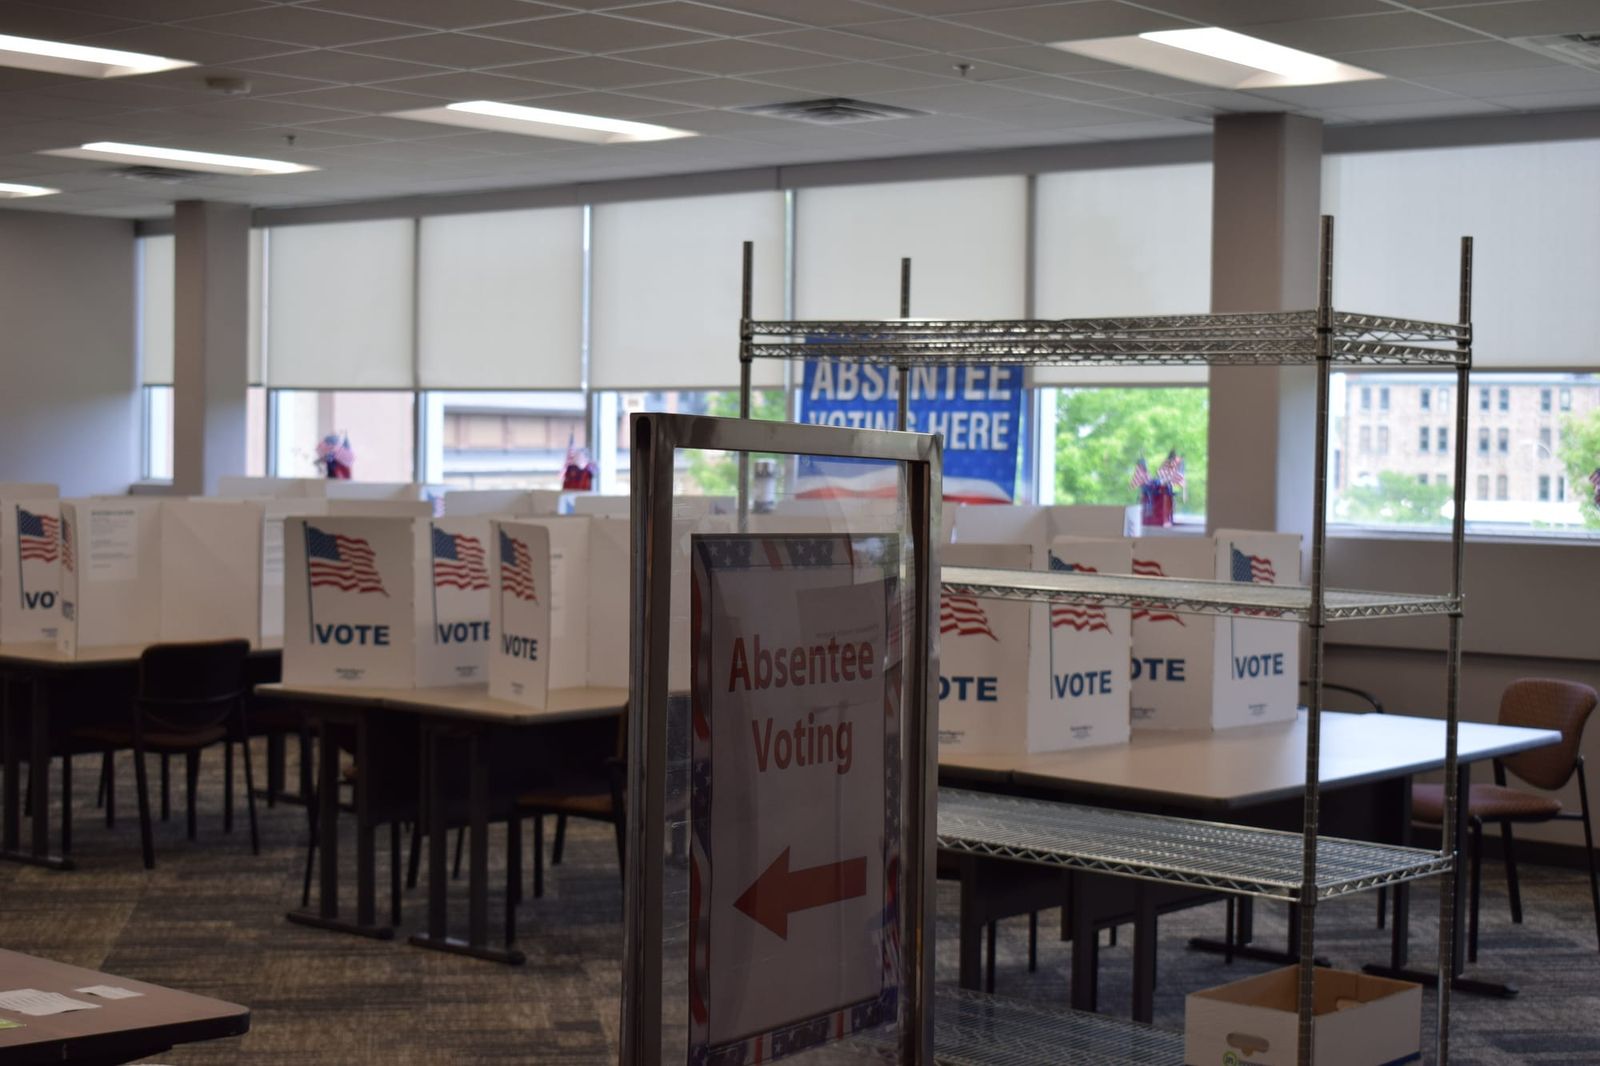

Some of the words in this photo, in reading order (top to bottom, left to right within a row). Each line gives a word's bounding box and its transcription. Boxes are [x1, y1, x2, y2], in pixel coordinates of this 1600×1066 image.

[928, 411, 1011, 450] HERE
[25, 590, 59, 609] VO
[316, 624, 390, 645] VOTE
[503, 634, 538, 660] VOTE
[728, 634, 874, 692] Absentee
[1235, 653, 1284, 678] VOTE
[1054, 670, 1112, 699] VOTE
[752, 712, 853, 775] Voting
